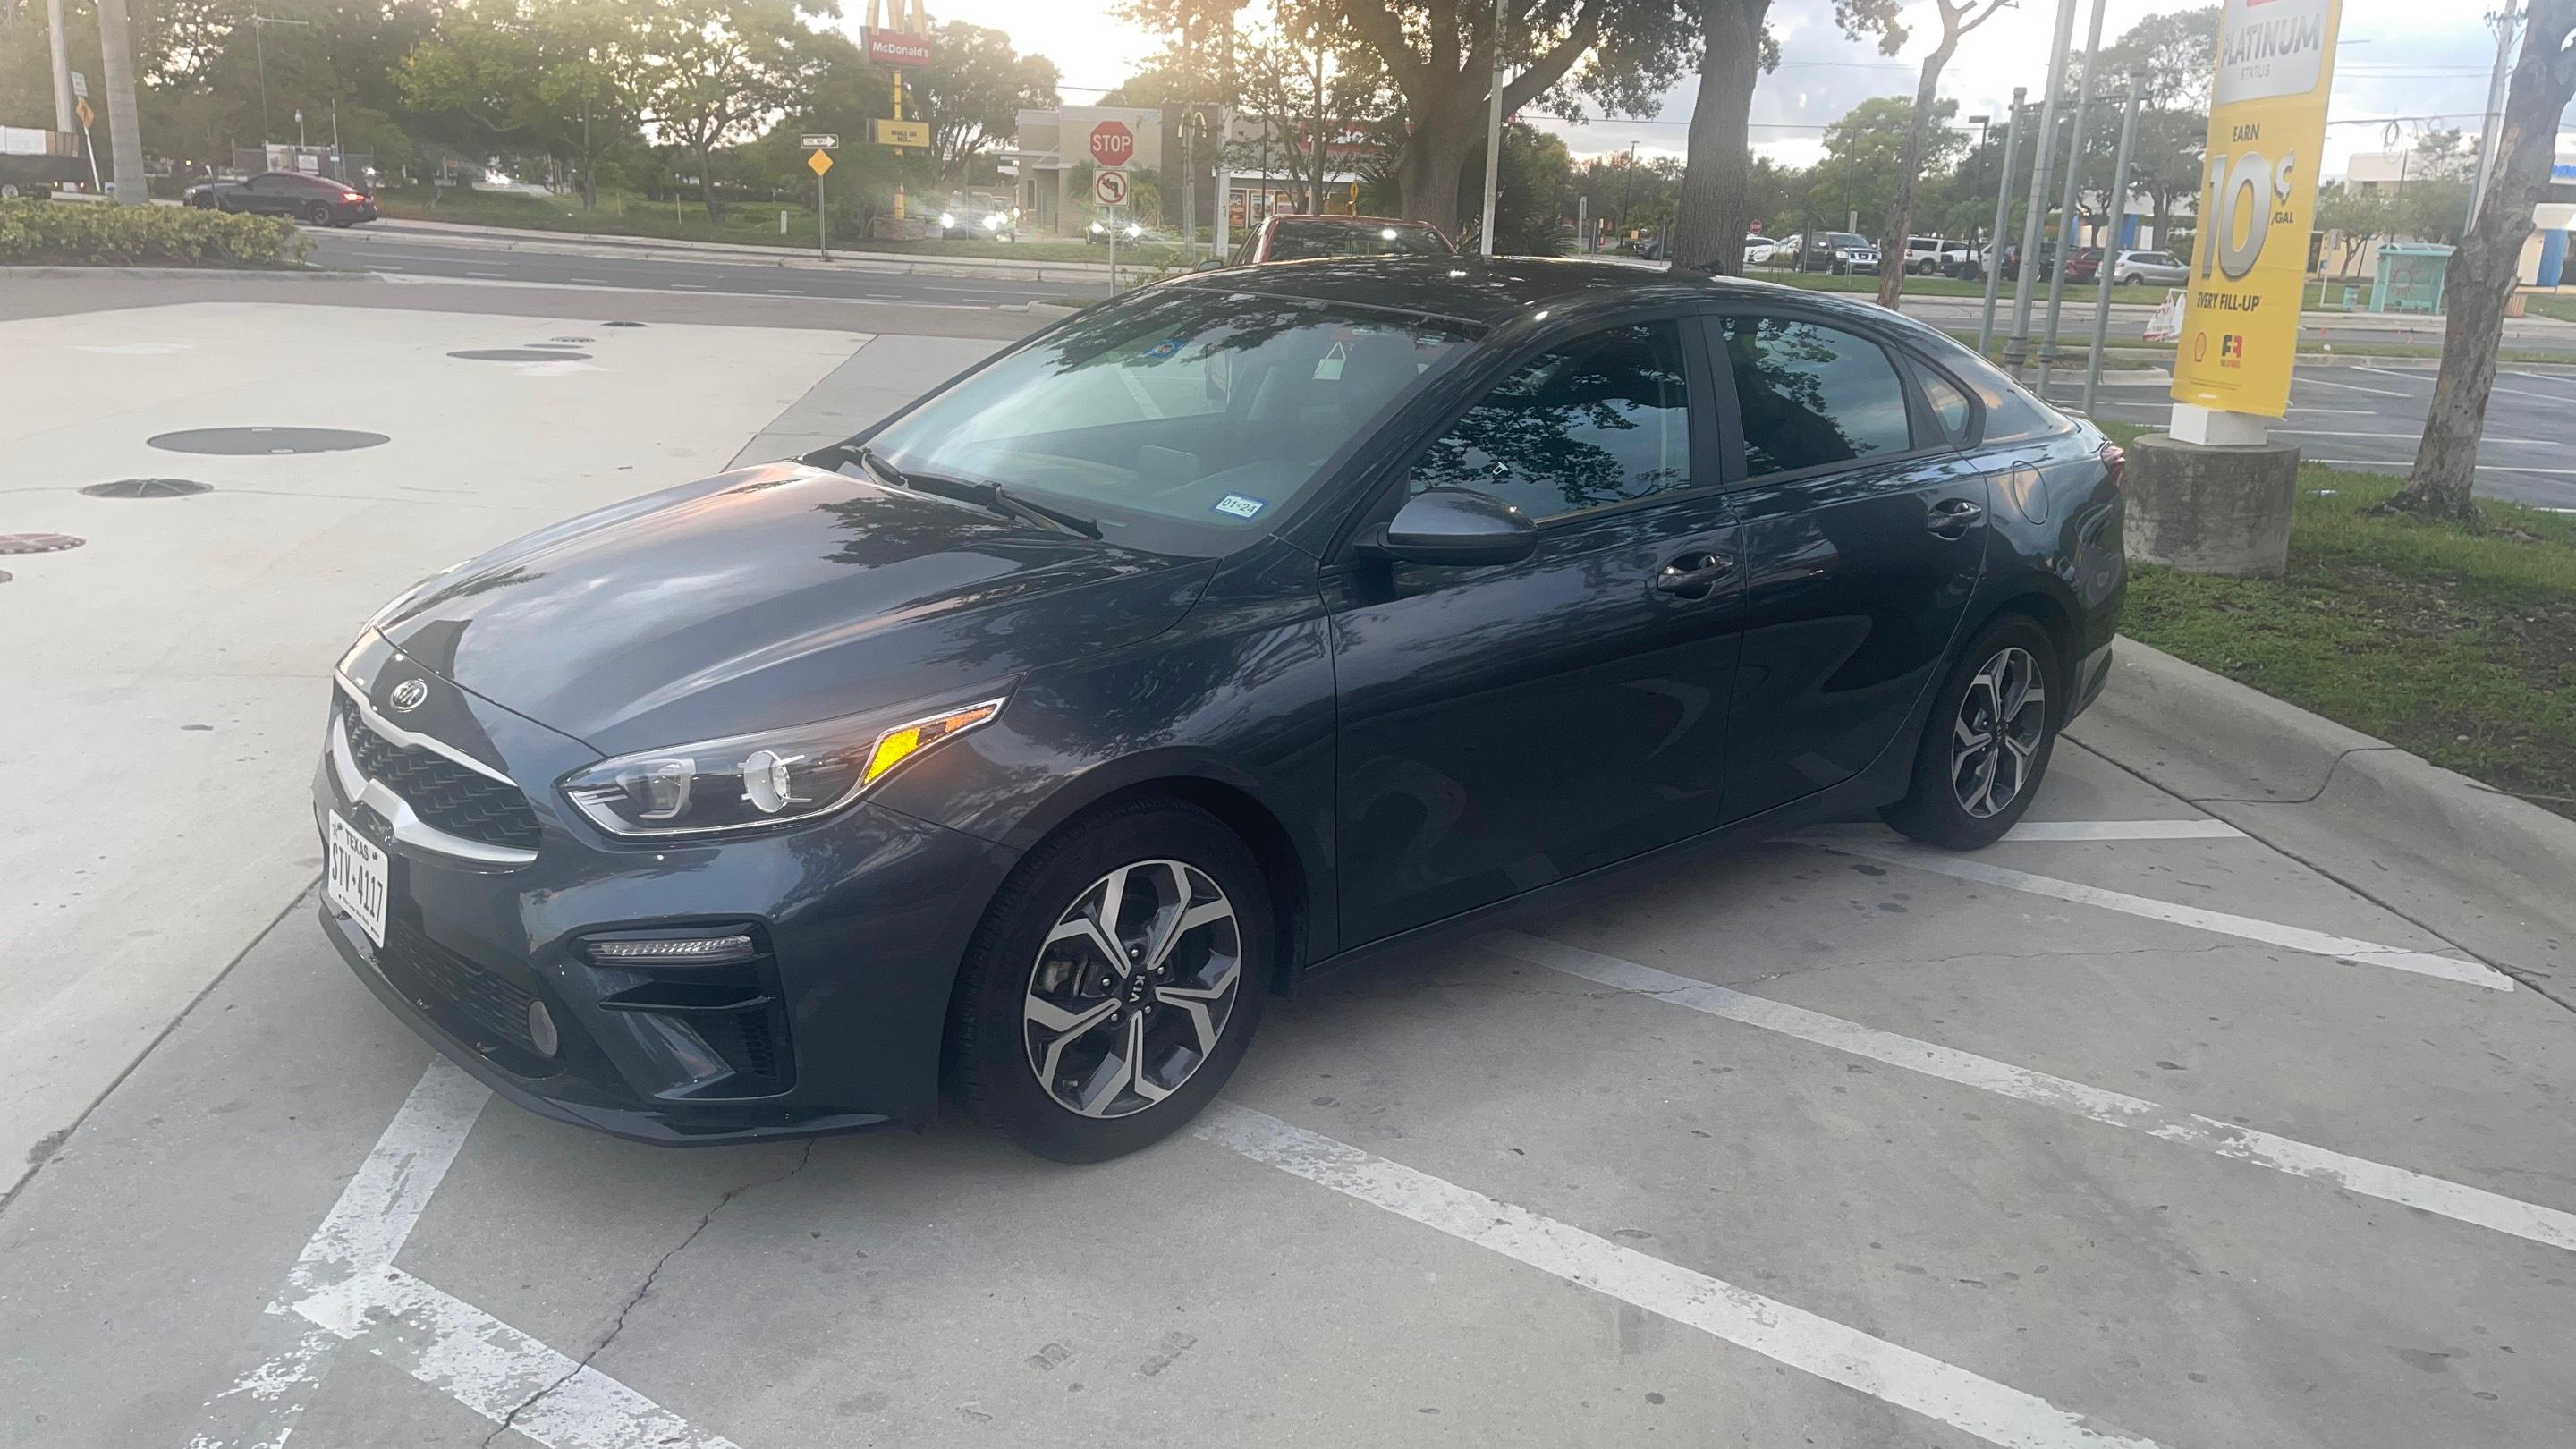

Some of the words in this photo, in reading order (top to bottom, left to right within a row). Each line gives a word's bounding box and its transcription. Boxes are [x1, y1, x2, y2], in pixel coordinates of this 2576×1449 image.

[872, 41, 929, 57] McDonald's
[2220, 13, 2322, 68] PLATINUM
[2241, 64, 2271, 80] STATUS
[2232, 123, 2260, 143] EARN
[1092, 134, 1131, 152] STOP
[2197, 292, 2218, 309] EVERY
[2219, 294, 2260, 311] FILL-UP
[345, 828, 369, 861] TEXAS
[1129, 975, 1145, 1002] KIA
